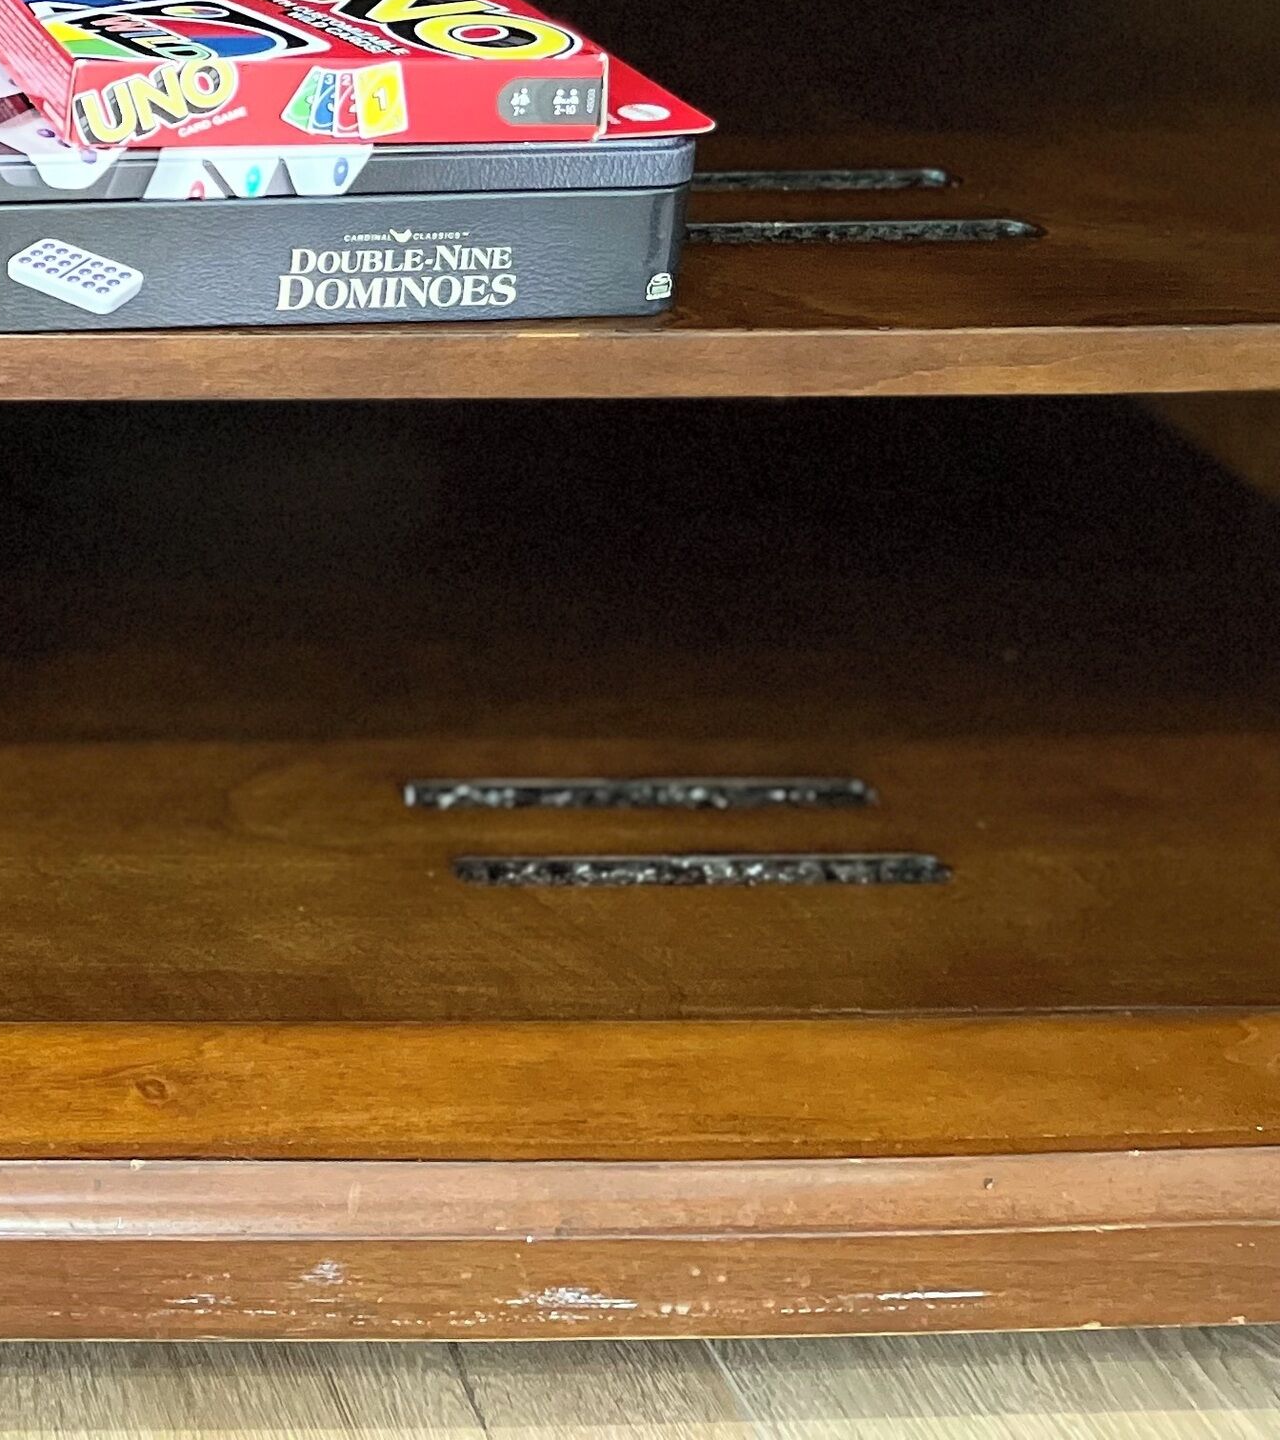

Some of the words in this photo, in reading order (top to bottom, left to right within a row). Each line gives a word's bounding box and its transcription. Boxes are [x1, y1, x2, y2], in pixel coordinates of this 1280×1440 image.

[91, 14, 213, 60] WILD
[76, 60, 236, 145] UNO
[371, 88, 387, 111] 1
[553, 104, 577, 116] 2-10
[343, 233, 391, 242] CARDINAL
[290, 245, 513, 274] DOUBLE-NINE
[275, 274, 517, 311] DOMINOES
